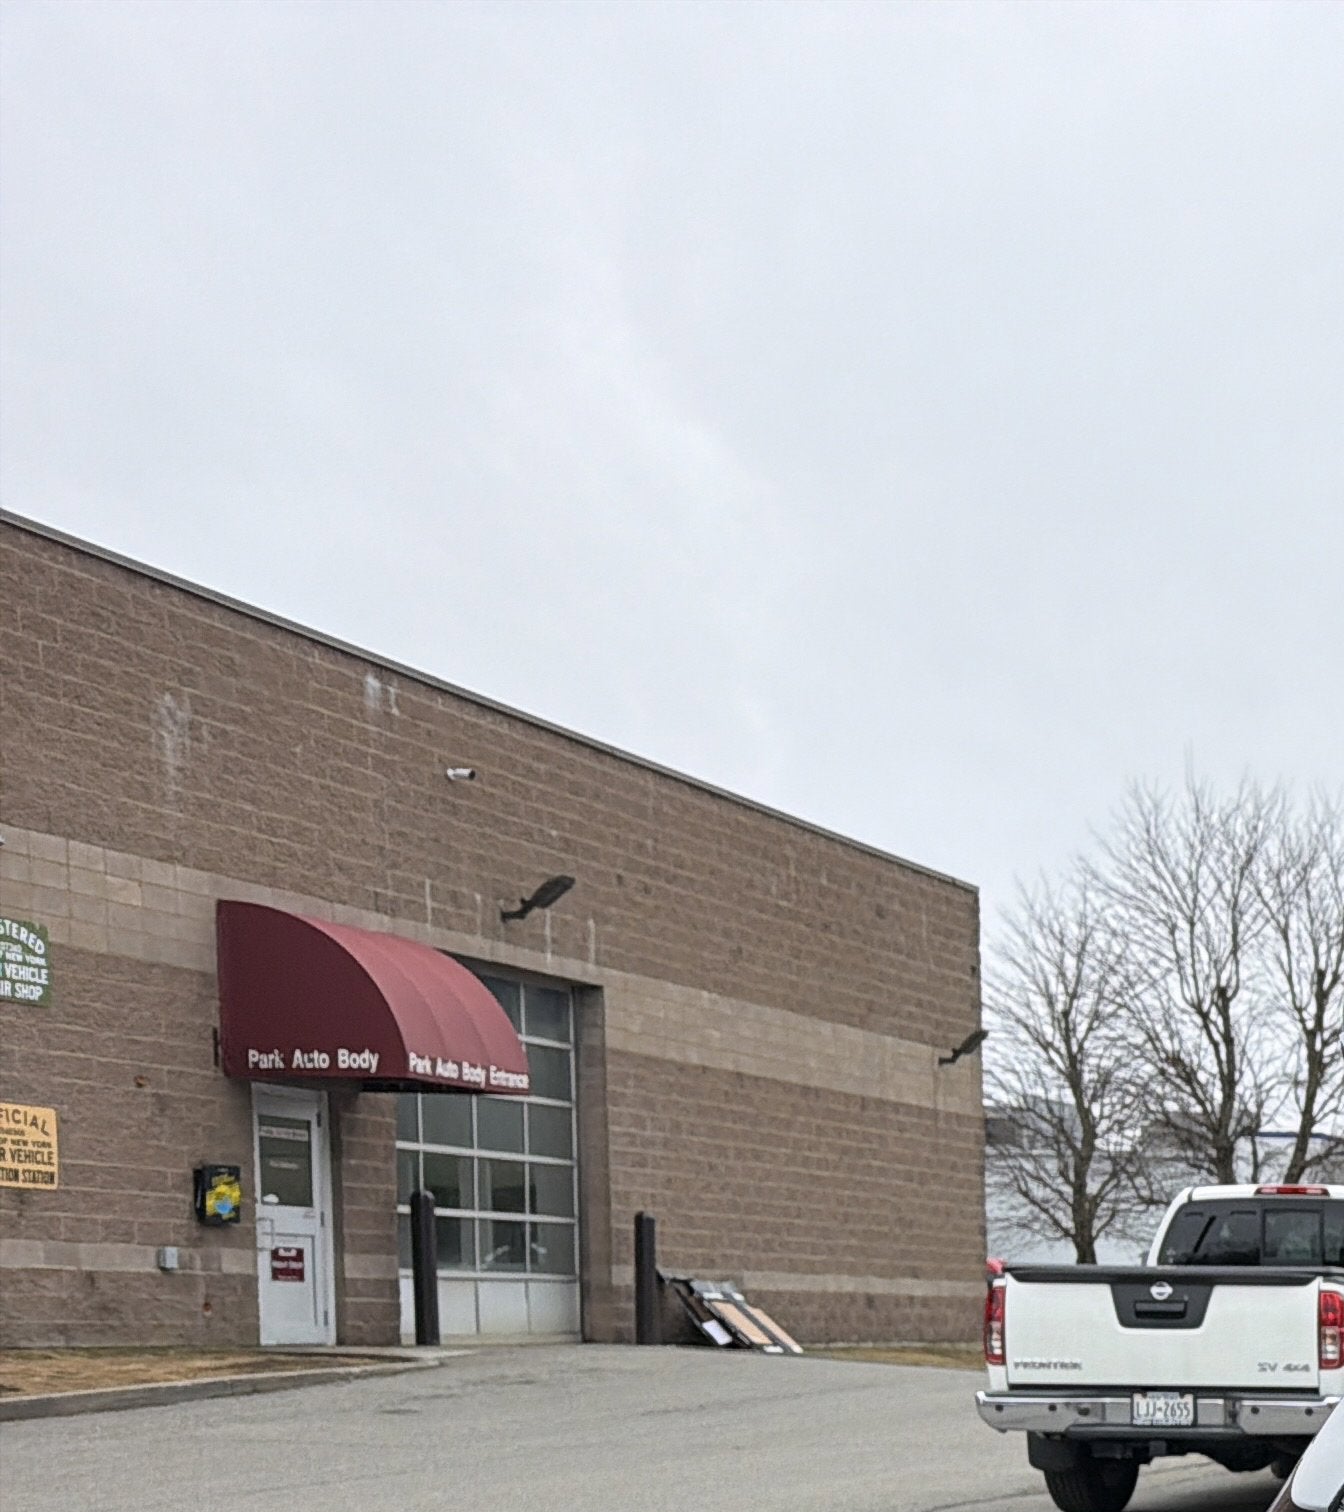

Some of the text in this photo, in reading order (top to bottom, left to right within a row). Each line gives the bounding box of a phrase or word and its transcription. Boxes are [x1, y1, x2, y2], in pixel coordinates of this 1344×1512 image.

[4, 962, 49, 986] VEHICLE
[14, 983, 43, 1000] SHOP
[247, 1048, 380, 1074] Park Auto Body
[408, 1051, 529, 1090] Park Auto Body Entrance
[9, 1148, 55, 1166] VEHICLE
